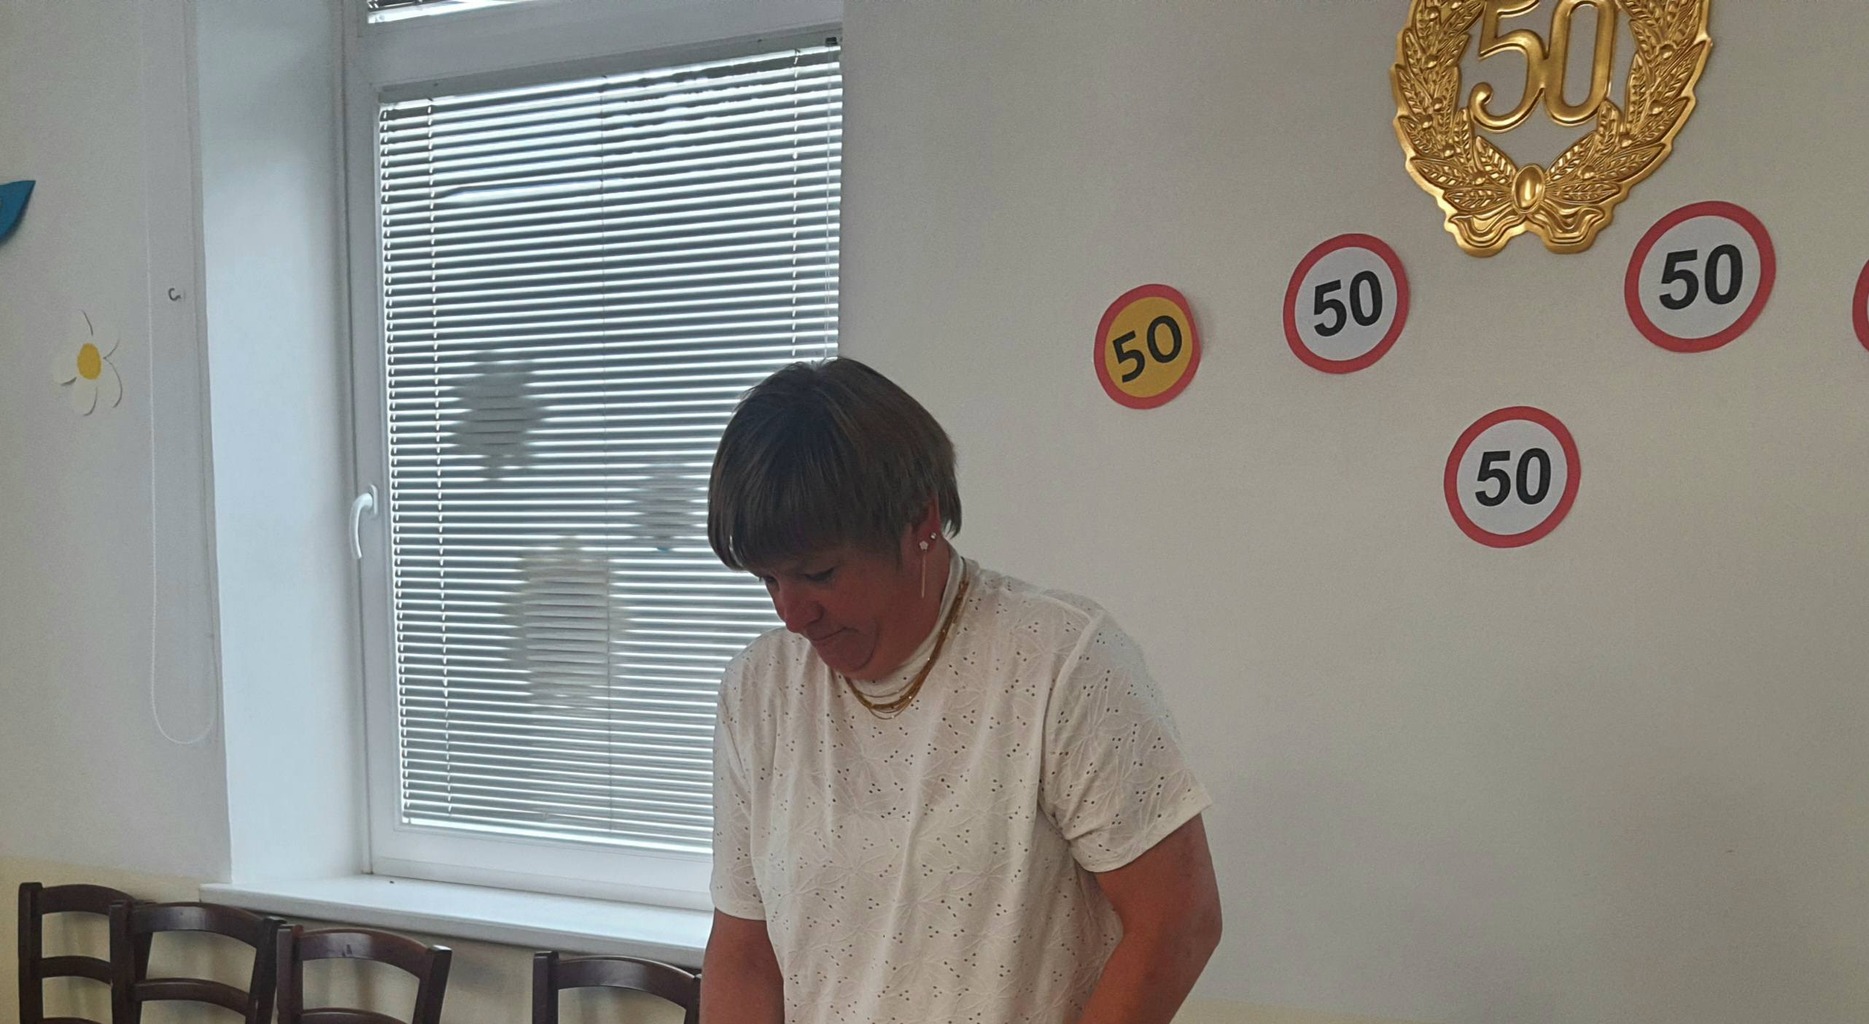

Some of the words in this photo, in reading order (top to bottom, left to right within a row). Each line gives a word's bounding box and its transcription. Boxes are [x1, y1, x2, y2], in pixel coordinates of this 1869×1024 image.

[1469, 0, 1618, 133] 50
[1313, 270, 1383, 337] 50
[1658, 243, 1744, 311] 50
[1112, 315, 1183, 383] 50
[1474, 447, 1552, 507] 50
